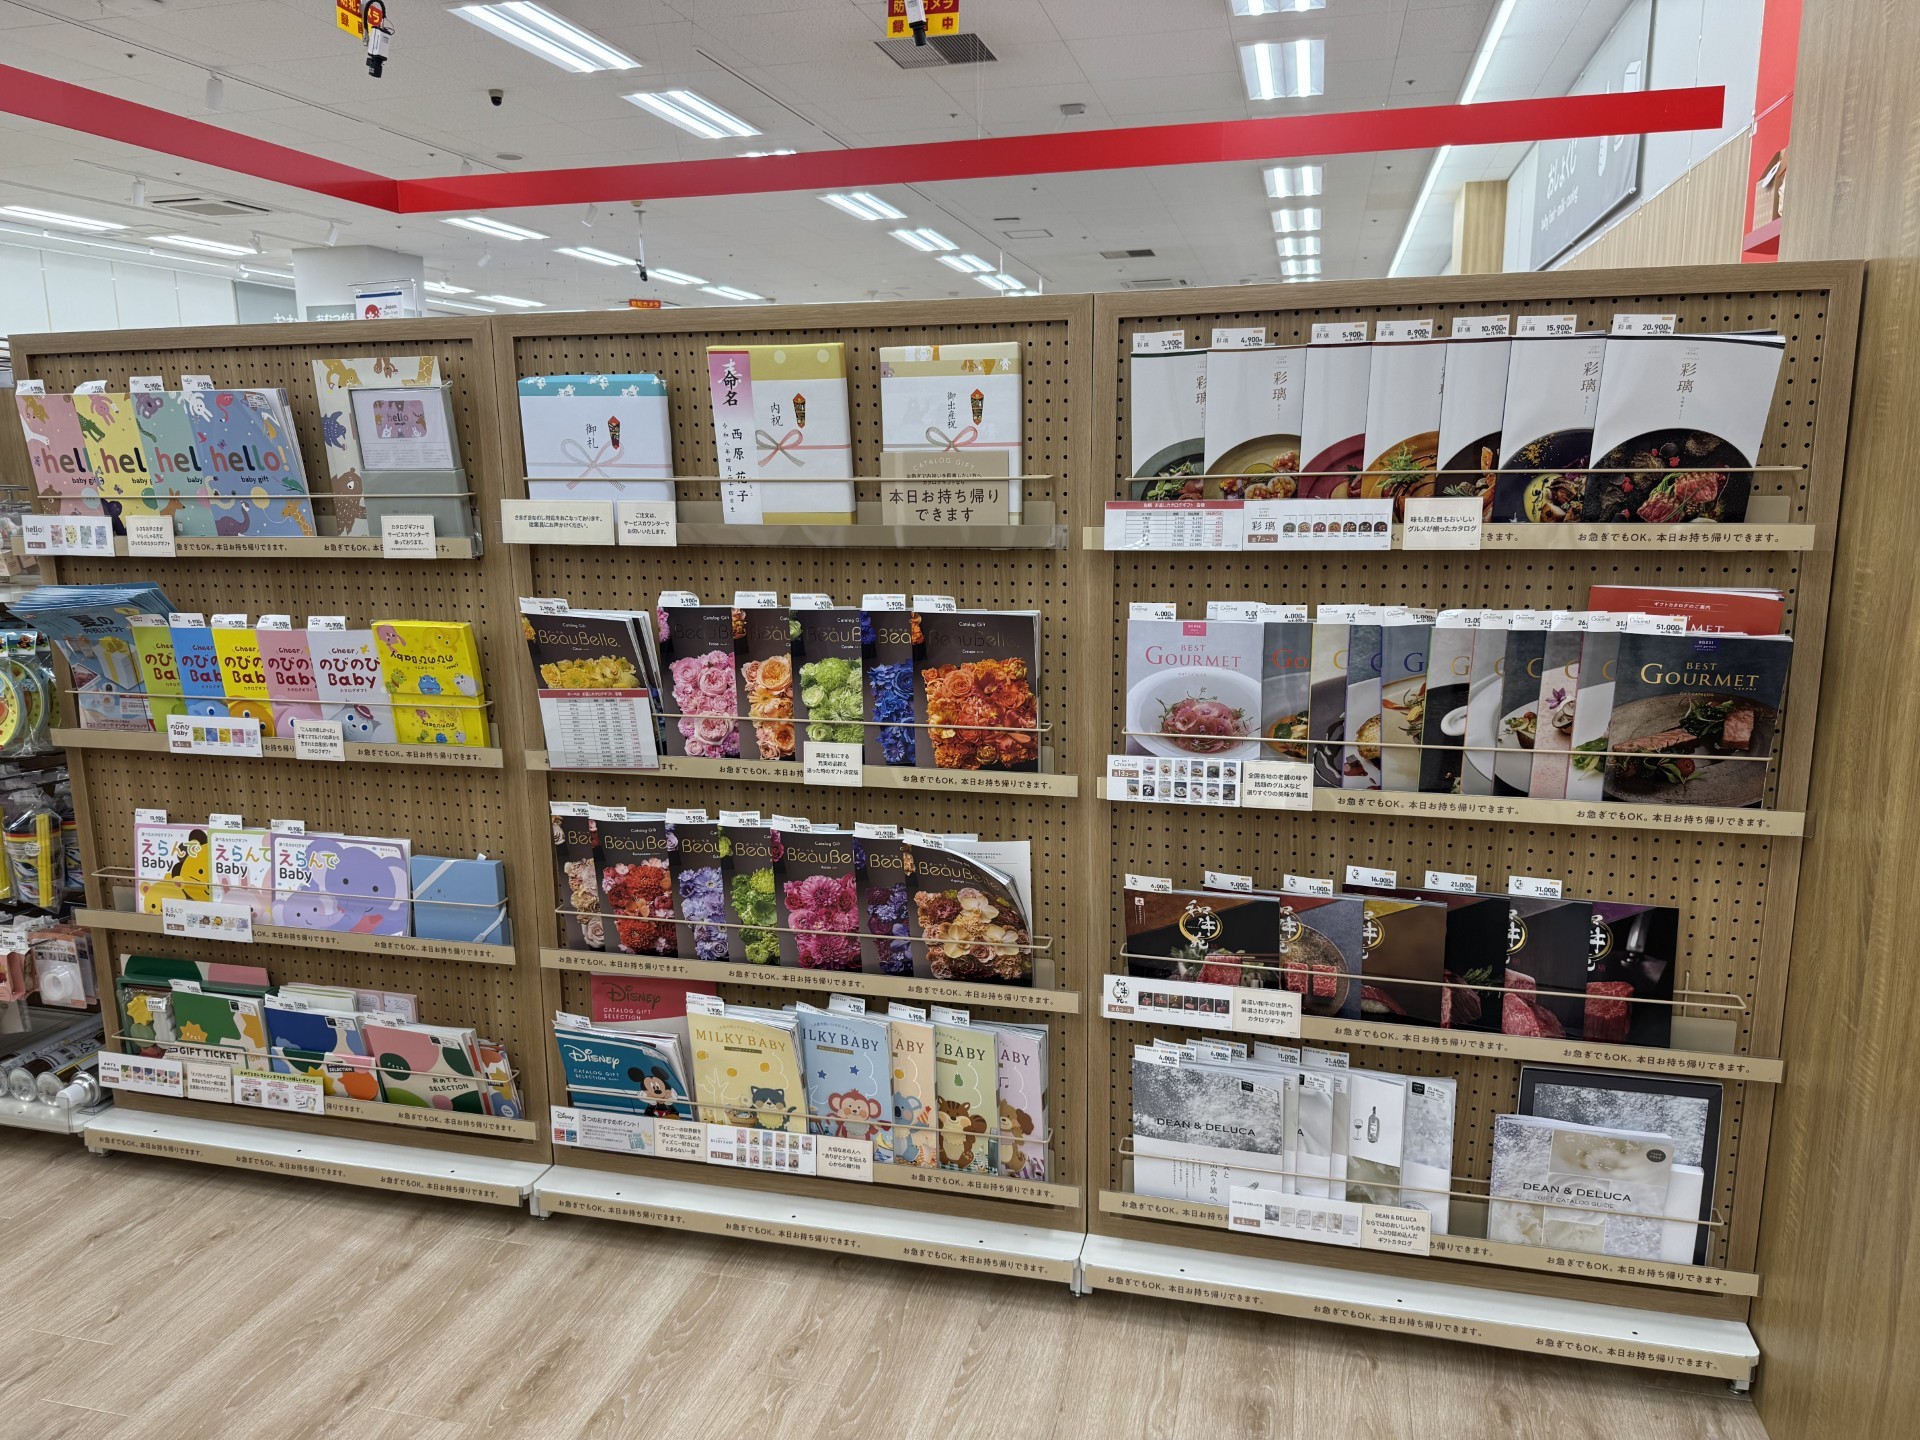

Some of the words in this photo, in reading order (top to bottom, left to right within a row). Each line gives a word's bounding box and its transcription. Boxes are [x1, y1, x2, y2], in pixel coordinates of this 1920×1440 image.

[1580, 361, 1599, 392] 彩璃
[1676, 362, 1697, 393] 彩璃
[722, 370, 739, 406] 命名
[1272, 371, 1287, 401] 彩璃
[770, 402, 784, 426] 内祝
[947, 392, 957, 428] 御出産祝
[586, 424, 598, 448] 御礼
[210, 445, 290, 472] hello!
[914, 458, 952, 471] CATALOG
[955, 458, 976, 471] GIFT
[890, 488, 998, 504] 本日お持ち帰り
[916, 507, 974, 522] できます
[1252, 521, 1275, 531] 彩璃
[1251, 535, 1275, 543] 全7コース
[1578, 532, 1780, 543] お急ぎでもOK。本日お持ち帰りできます。
[1654, 601, 1711, 610] ギフトカタログのご案内
[538, 630, 618, 647] BeauBelle
[320, 657, 380, 672] のびのび
[1145, 646, 1241, 667] GOURMET
[1272, 648, 1308, 669] Go
[1686, 662, 1717, 670] BEST
[328, 673, 376, 688] Baby
[1640, 664, 1759, 688] GOURMET
[358, 749, 482, 761] お急ぎでもOK。本日お持ち帰りできます。
[902, 776, 1052, 790] お急ぎでもOK。本日お持ち帰りできます。
[1248, 773, 1308, 781] 全国各地の老舗の味や
[1247, 790, 1308, 798] 選りすぐりの美味が集結
[1337, 796, 1519, 815] お急ぎでもOK。本日お持ち帰りできます。
[1577, 810, 1771, 828] お急ぎでもOK。本日お持ち帰りできます。
[142, 839, 200, 857] えらんで
[605, 836, 668, 850] BeauBe
[142, 857, 174, 871] Baby
[279, 849, 340, 869] えらんで
[216, 862, 247, 877] Baby
[279, 868, 312, 883] Baby
[919, 862, 999, 891] BeauBelle
[374, 941, 495, 958] お急ぎでもOK。本日お持ち帰りできます。
[558, 955, 689, 975] お急ぎでもOK。本日お持ち帰りできます。
[728, 970, 867, 989] お急ぎでもOK。本日お持ち帰りできます。
[907, 985, 1055, 1006] お急ぎでもOK。本日お持ち帰りできます。
[1241, 999, 1293, 1009] 奥深い和牛の世界へ
[1241, 1007, 1293, 1017] 厳選された和牛専門
[1247, 1016, 1285, 1024] カタログギフト
[696, 1029, 744, 1044] MILKY
[749, 1036, 785, 1051] BABY
[840, 1034, 879, 1051] BABY
[896, 1039, 924, 1053] ABY
[1334, 1026, 1509, 1052] お急ぎでもOK。本日お持ち帰りできます。
[180, 1046, 201, 1057] GIFT
[204, 1049, 237, 1060] TICKET
[944, 1043, 986, 1060] BABY
[1001, 1049, 1030, 1066] ABY
[1564, 1048, 1751, 1074] お急ぎでもOK。本日お持ち帰りできます。
[429, 1083, 468, 1092] SELECTION
[398, 1112, 518, 1133] お急ぎでもOK。本日お持ち帰りできます。
[658, 1123, 701, 1134] ディズニーの世界観を
[1157, 1118, 1190, 1128] DEAN
[1206, 1124, 1256, 1136] DELUCA
[98, 1136, 203, 1156] お急ぎでもOK。本日お持ち帰りできます。
[662, 1138, 699, 1148] ディズニー好きには
[666, 1146, 696, 1155] たまらない一冊
[828, 1146, 861, 1156] 大切なあの人へ
[235, 1155, 346, 1178] お急ぎでもOK。本日お持ち帰りできます。
[828, 1160, 861, 1170] 心からの贈り物
[380, 1176, 499, 1198] お急ぎでもOK。本日お持ち帰りできます。
[911, 1172, 1056, 1198] お急ぎでもOK。本日お持ち帰りできます。
[1522, 1182, 1560, 1194] DEAN
[1564, 1186, 1572, 1195] &
[1576, 1188, 1631, 1202] DELUCA
[1556, 1198, 1589, 1206] CATALOG
[558, 1199, 688, 1224] お急ぎでもOK。本日お持ち帰りできます。
[1366, 1220, 1426, 1232] ならではのおいしいものを
[1373, 1229, 1418, 1239] たっぷり詰め込んだ
[725, 1222, 862, 1248] お急ぎでもOK。本日お持ち帰りできます。
[1378, 1237, 1412, 1247] ギフトカタログ
[903, 1247, 1049, 1274] お急ぎでもOK。本日お持ち帰りできます。
[1546, 1256, 1727, 1287] お急ぎでもOK。本日お持ち帰りできます。
[1107, 1275, 1263, 1304] お急ぎでもOK。本日お持ち帰りできます。
[1313, 1305, 1482, 1337] お急ぎでもOK。本日お持ち帰りできます。
[1535, 1336, 1719, 1371] お急ぎでもOK。本日お持ち帰りできます。
